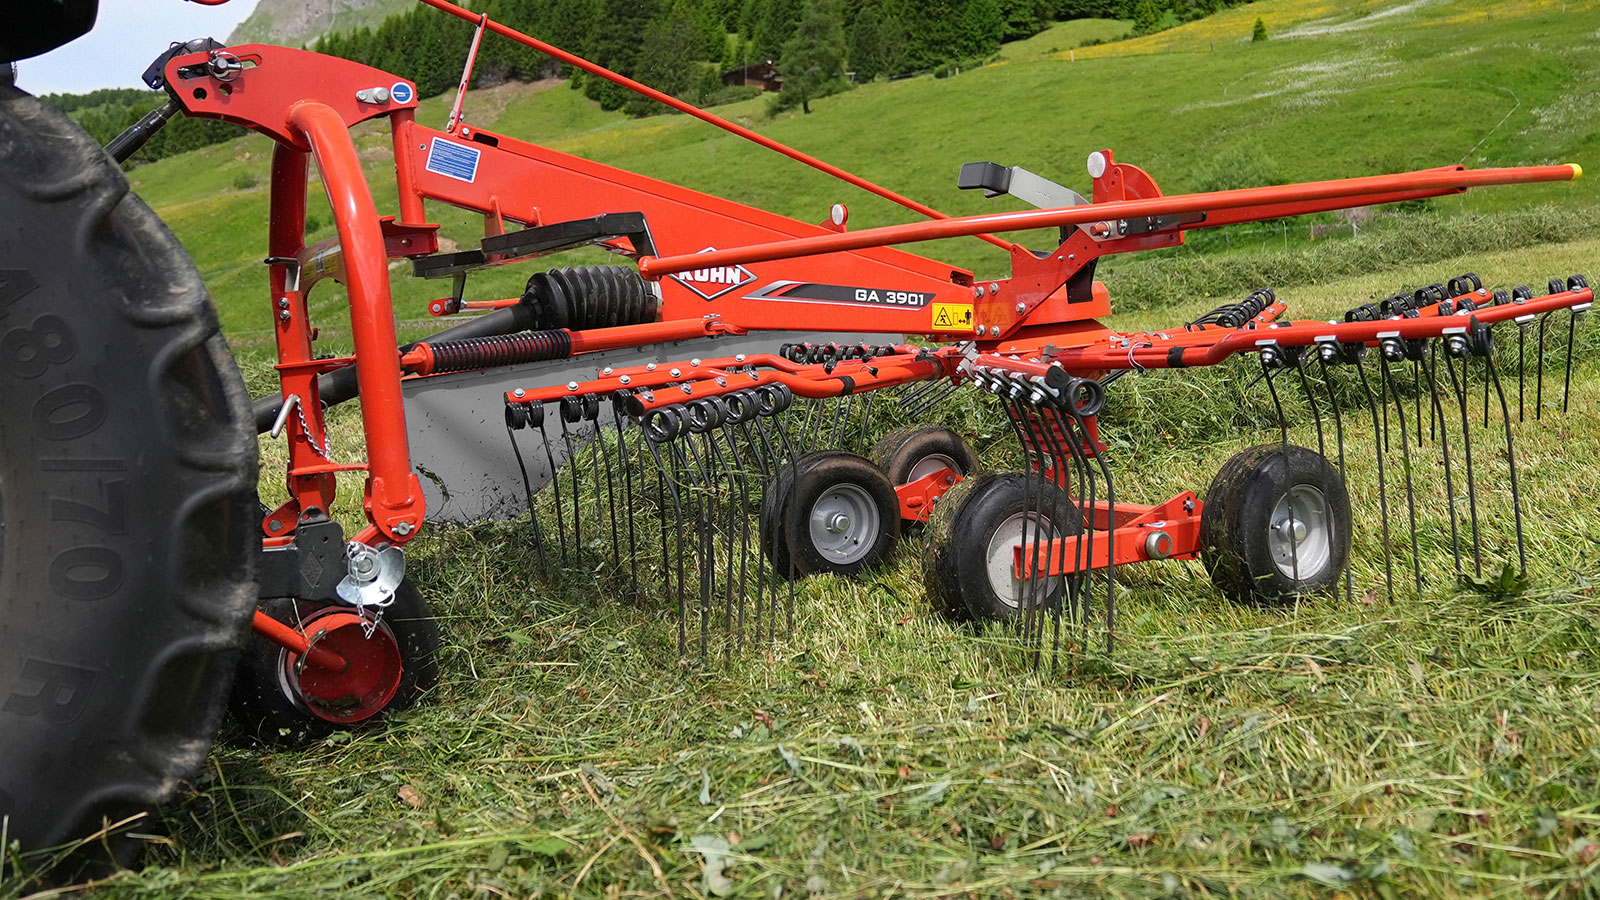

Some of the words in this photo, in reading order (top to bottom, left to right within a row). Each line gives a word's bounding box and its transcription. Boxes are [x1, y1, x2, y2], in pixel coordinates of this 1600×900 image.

[678, 266, 741, 285] KUHN
[855, 288, 880, 303] GA
[886, 291, 924, 306] 3901
[4, 657, 100, 726] R
